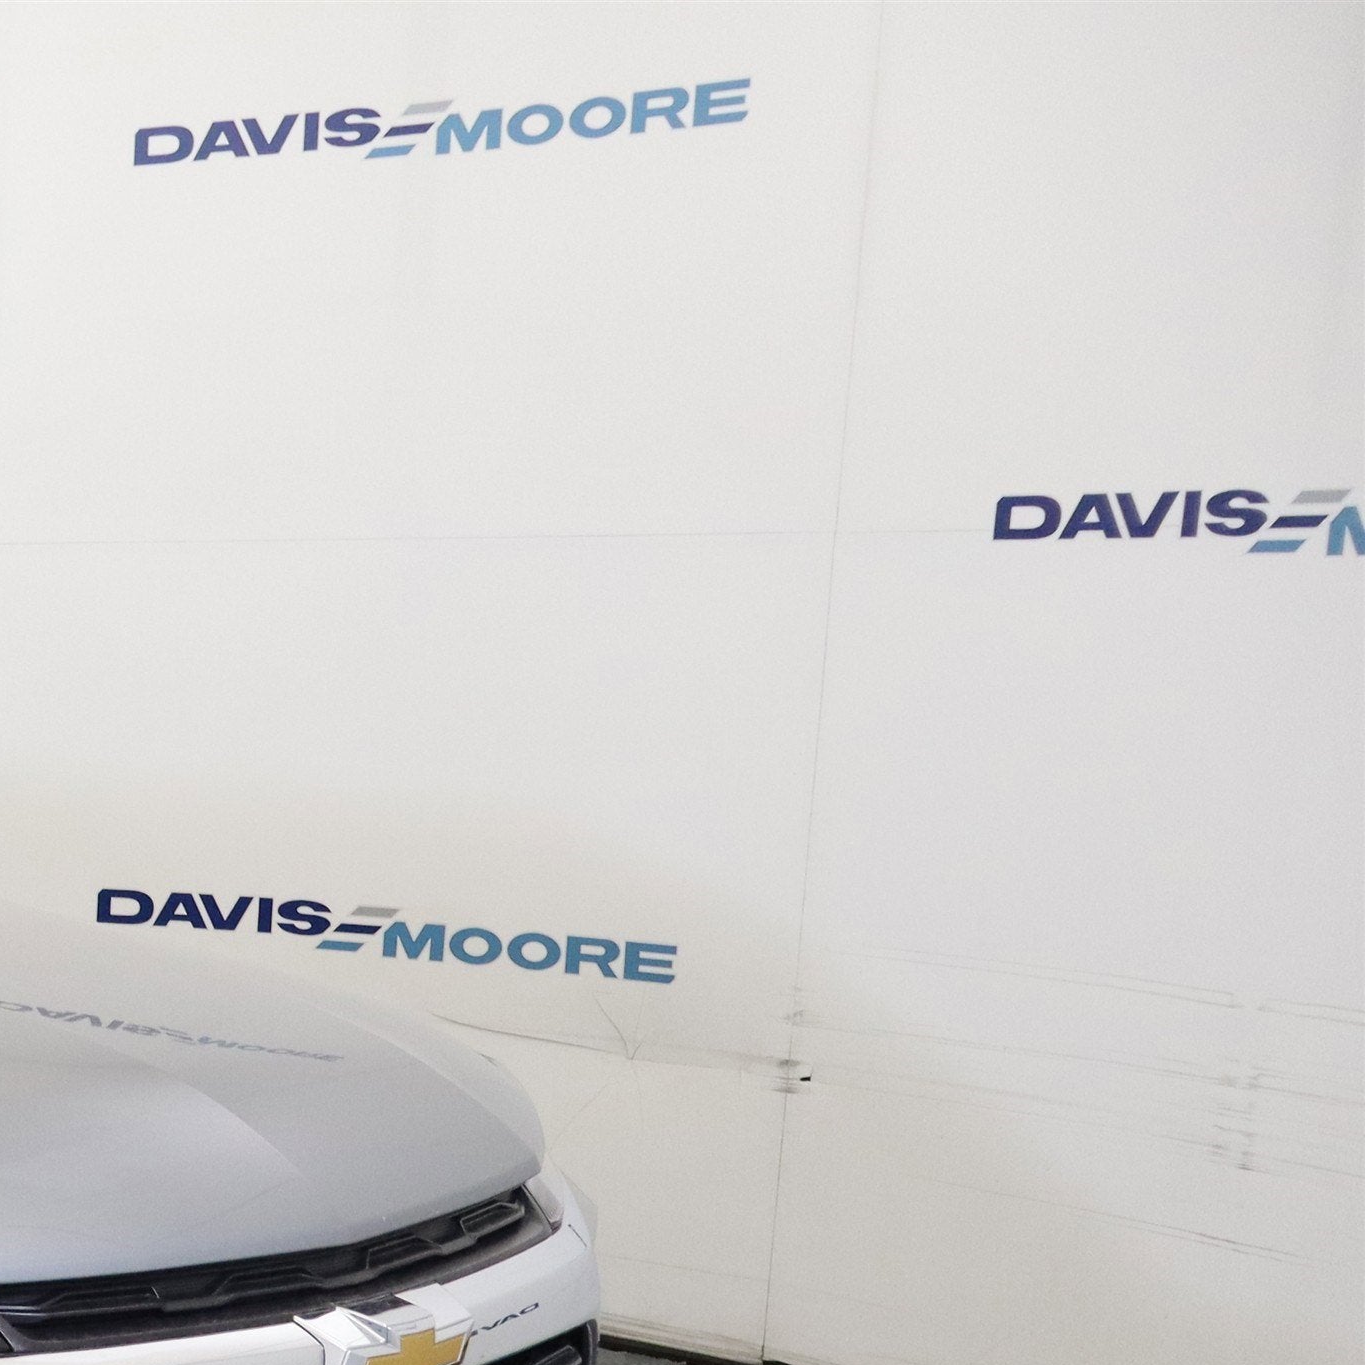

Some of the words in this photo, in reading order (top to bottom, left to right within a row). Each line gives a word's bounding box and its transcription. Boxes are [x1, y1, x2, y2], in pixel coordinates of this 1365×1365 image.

[133, 107, 380, 166] DAVIS
[434, 77, 751, 155] MOORE
[993, 489, 1270, 540] DAVIS
[96, 888, 331, 937] DAVIS
[382, 921, 678, 984] MOORE
